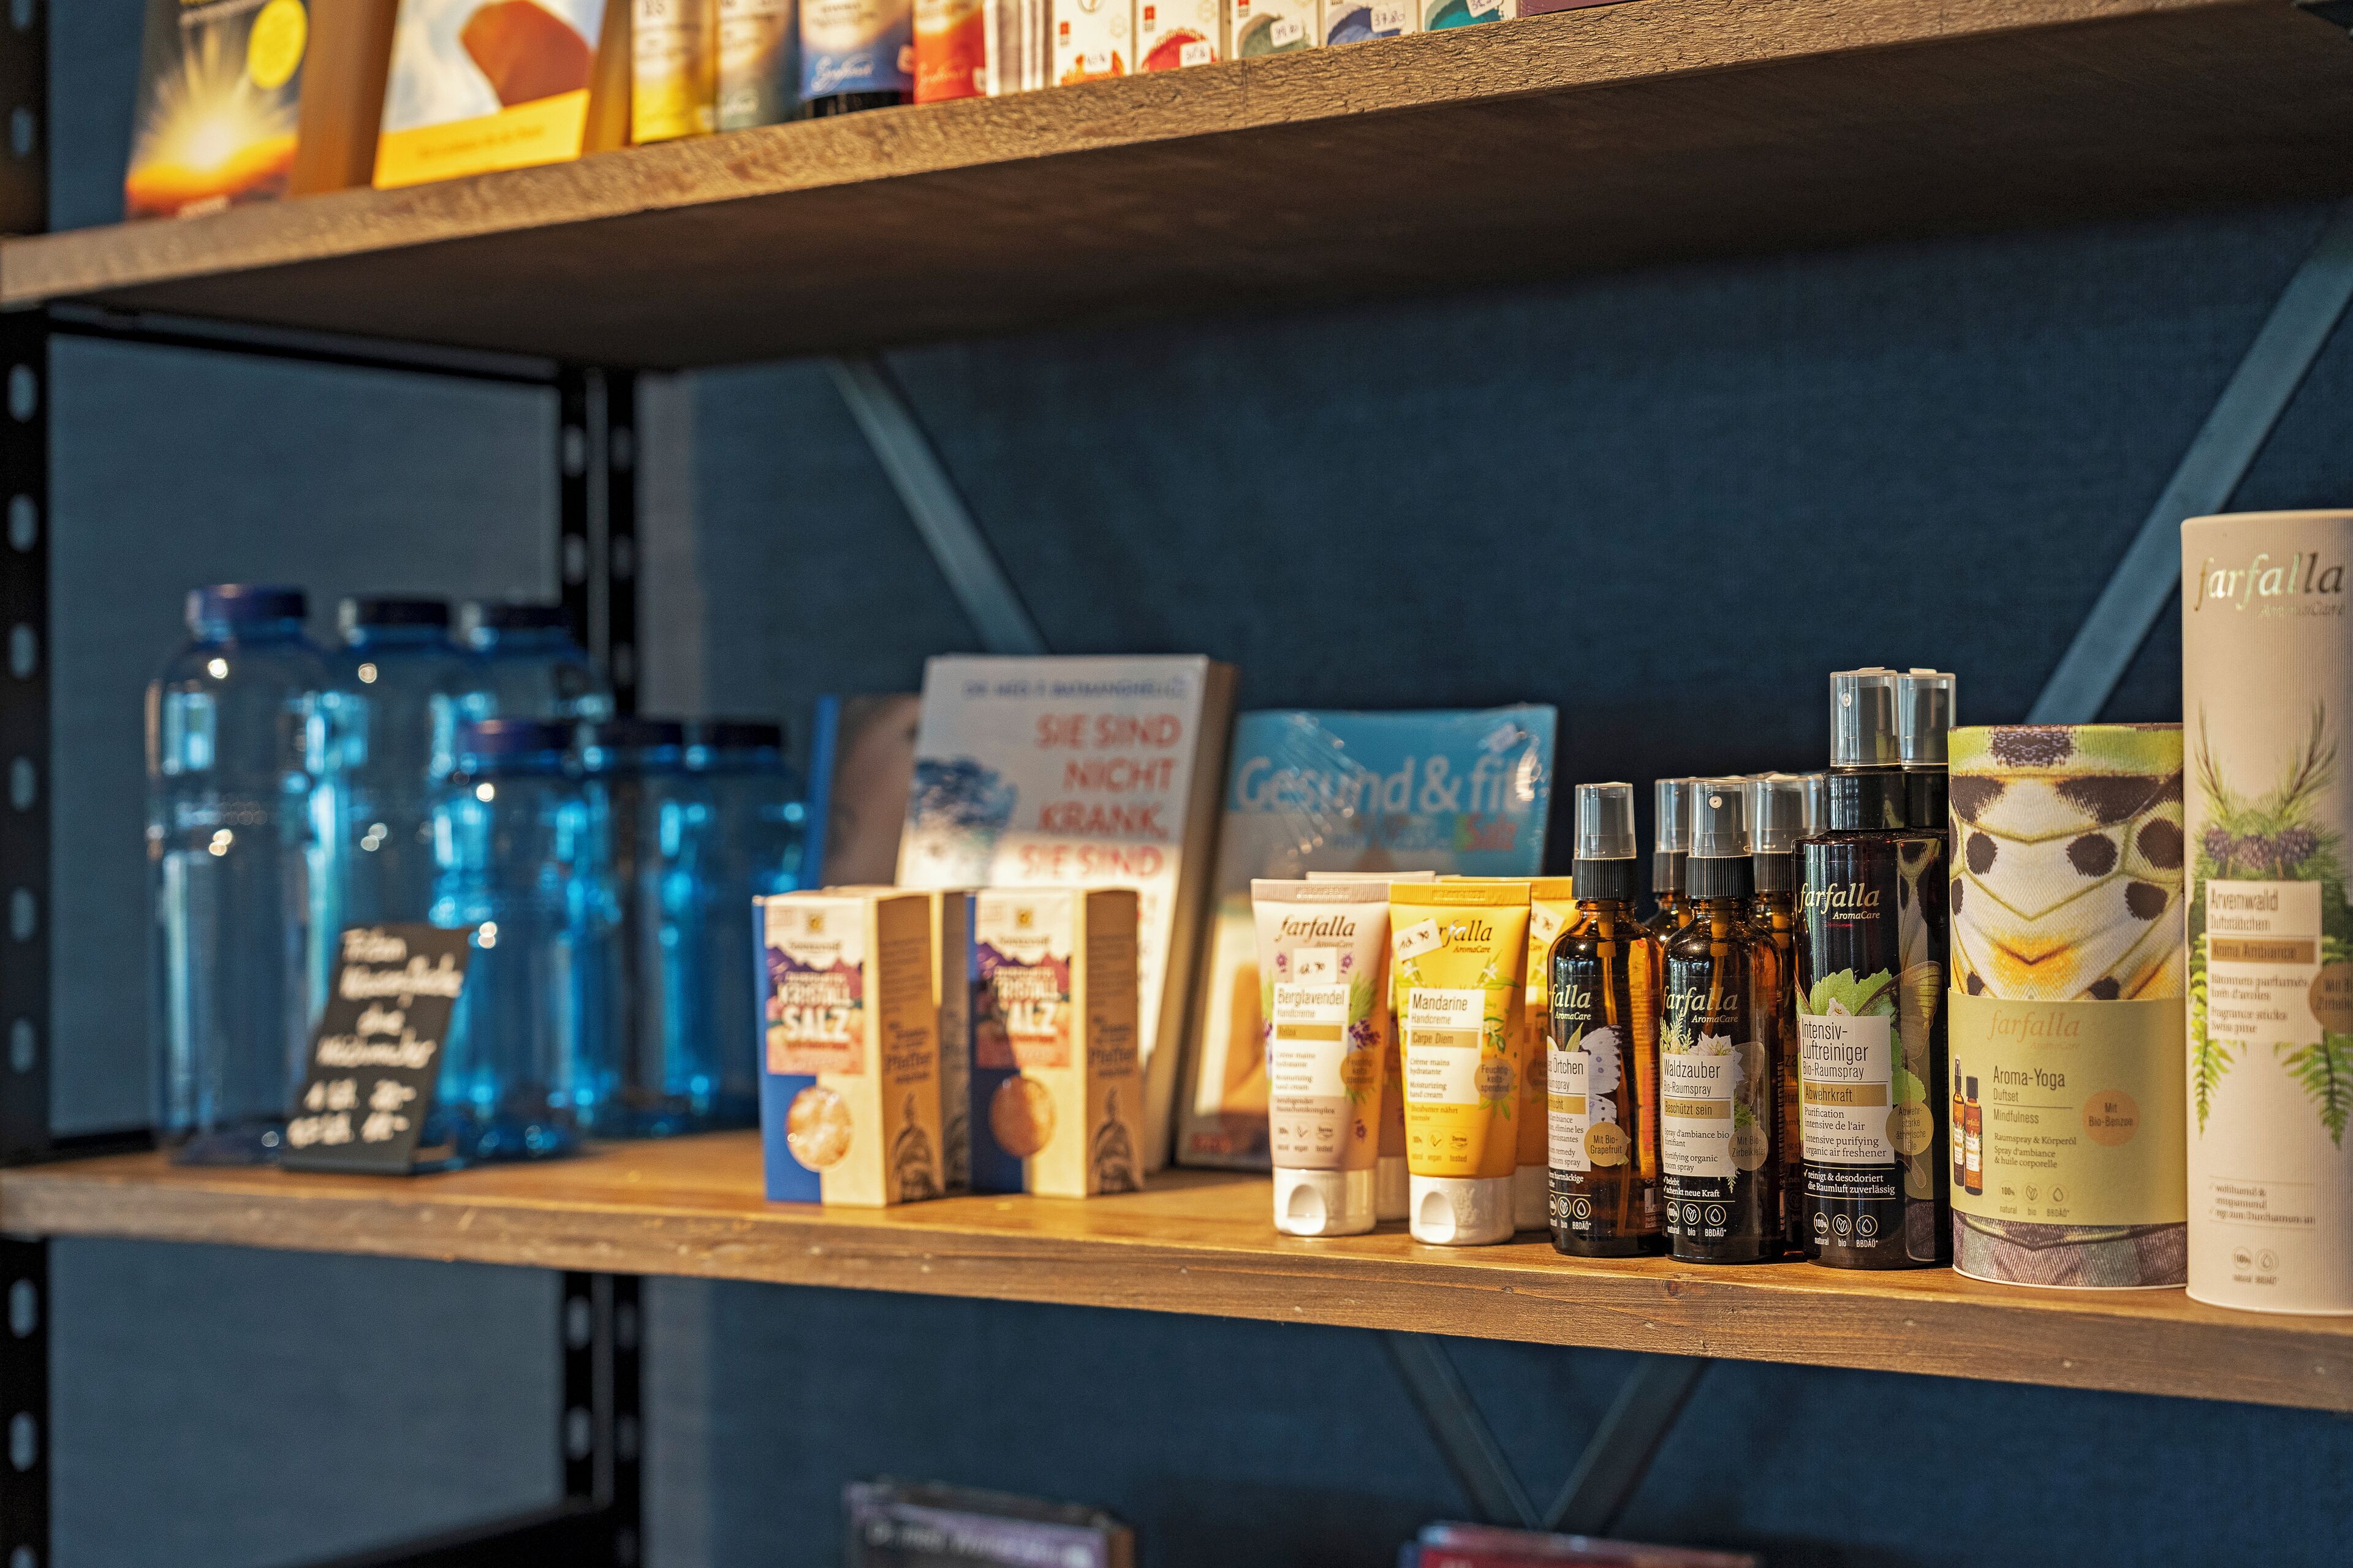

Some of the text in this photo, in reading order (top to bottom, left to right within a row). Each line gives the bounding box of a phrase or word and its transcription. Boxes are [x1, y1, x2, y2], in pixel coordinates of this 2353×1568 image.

[2194, 552, 2343, 612] farfalla
[1036, 713, 1183, 749] SIE SIND
[1063, 758, 1177, 792] NICHT
[1237, 755, 1415, 809] Gesund
[1419, 754, 1462, 811] &
[1020, 844, 1164, 877] SIE SIND
[1798, 883, 1880, 915] farfalla
[2210, 888, 2279, 911] Arvenwald
[1832, 911, 1881, 920] AromaCare
[1275, 915, 1356, 942] farfalla
[1438, 919, 1493, 948] rfalla
[1278, 988, 1344, 1008] Berglavendel
[1412, 993, 1468, 1010] Mandarine
[1548, 983, 1591, 1012] falla
[1661, 985, 1738, 1017] farfalla
[1412, 1013, 1451, 1025] Handcreme
[1555, 1011, 1591, 1020] AromaCare
[1691, 1014, 1738, 1023] AromaCare
[782, 1005, 851, 1040] SALZ
[1802, 1018, 1848, 1040] Intensiv-
[1987, 1009, 2081, 1043] farfalla
[1412, 1032, 1454, 1044] Carpe Diem
[1802, 1039, 1869, 1065] Luftreiniger
[1553, 1055, 1583, 1075] Örtchen
[1664, 1058, 1721, 1078] Waldzauber
[1803, 1061, 1865, 1080] Bio-Raumspray
[1993, 1065, 2066, 1091] Aroma-Yoga
[1664, 1080, 1711, 1096] Bio-Raumspray
[1805, 1086, 1853, 1102] Abwehrkraft
[1993, 1088, 2019, 1102] Duftset
[1665, 1100, 1713, 1116] Beschützt sein
[1805, 1107, 1844, 1119] Purification
[1898, 1106, 1923, 1116] Abwehr-
[1902, 1118, 1920, 1127] starke
[1993, 1108, 2039, 1124] Mindfulness
[1805, 1120, 1833, 1130] intensive
[1835, 1121, 1846, 1131] de
[1593, 1134, 1618, 1145] Mit Bio-
[1677, 1129, 1715, 1139] d'ambiance
[1717, 1131, 1730, 1139] bio
[1737, 1135, 1762, 1146] Mit Bio-
[1805, 1133, 1879, 1148] Intensive purifying
[1896, 1129, 1927, 1140] ätherische
[1994, 1132, 2032, 1145] Raumspray
[2042, 1136, 2077, 1146] Körperöl
[1590, 1145, 1623, 1156] Grapefruit
[1665, 1151, 1689, 1163] Fortifying
[1732, 1147, 1766, 1157] Zirbelkiefer
[1805, 1146, 1887, 1157] organic air freshener
[1994, 1145, 2056, 1158] Spray d'ambiance
[1564, 1159, 1581, 1168] spray
[1677, 1164, 1694, 1173] spray
[2001, 1156, 2018, 1165] huile
[2019, 1159, 2058, 1169] corporelle
[1666, 1178, 1680, 1186] belebt
[1808, 1171, 1884, 1183] reinigt & desodoriert
[1666, 1186, 1684, 1195] schenkt
[1816, 1183, 1848, 1193] Raumluft
[1849, 1185, 1895, 1195] zuverlässig
[2001, 1187, 2015, 1196] 100%
[1815, 1218, 1828, 1229] 100%
[1687, 1227, 1696, 1237] bio
[1838, 1238, 1847, 1248] bio
